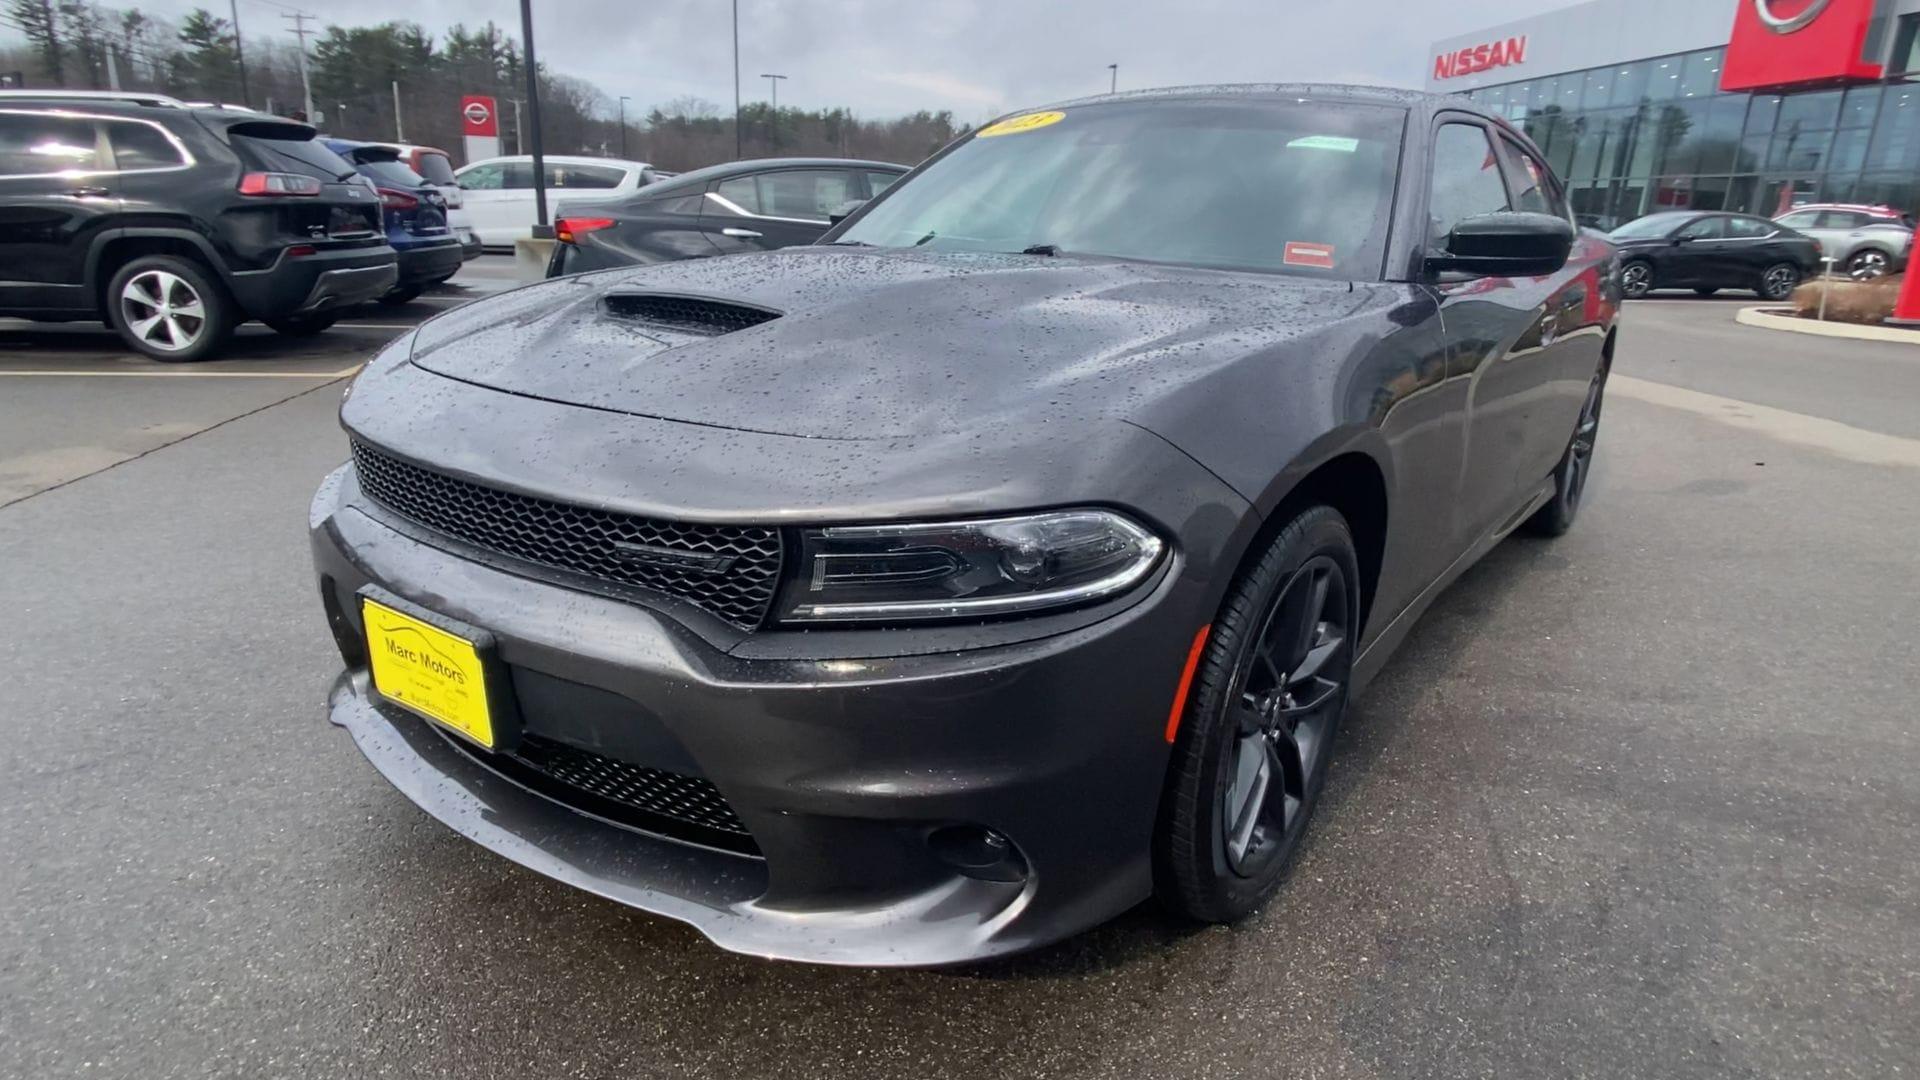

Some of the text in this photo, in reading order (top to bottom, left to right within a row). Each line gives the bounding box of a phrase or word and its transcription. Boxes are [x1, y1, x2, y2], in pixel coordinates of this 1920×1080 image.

[1433, 36, 1526, 80] NISSAN
[385, 637, 417, 663] Marc
[421, 652, 464, 685] Motors
